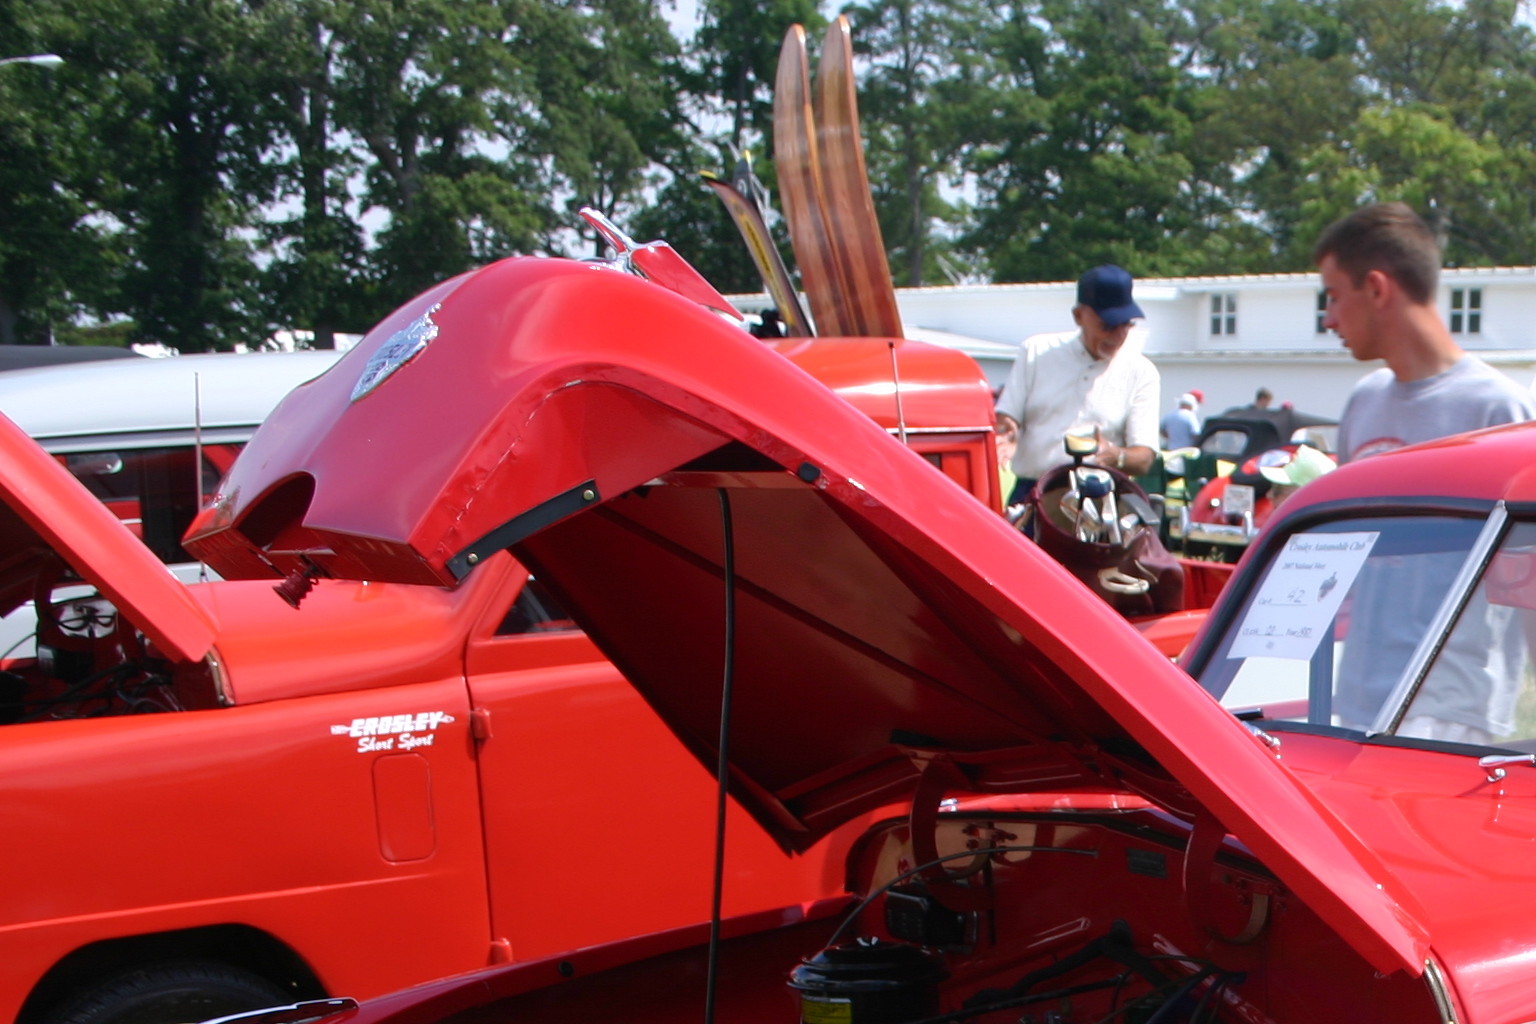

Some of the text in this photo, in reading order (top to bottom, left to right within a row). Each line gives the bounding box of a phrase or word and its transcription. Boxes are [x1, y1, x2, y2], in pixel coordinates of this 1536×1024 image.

[1289, 541, 1366, 553] Crosley Automobile Club
[1287, 587, 1305, 604] 42
[349, 711, 444, 738] CROSLEY
[357, 733, 435, 753] Short Sport
